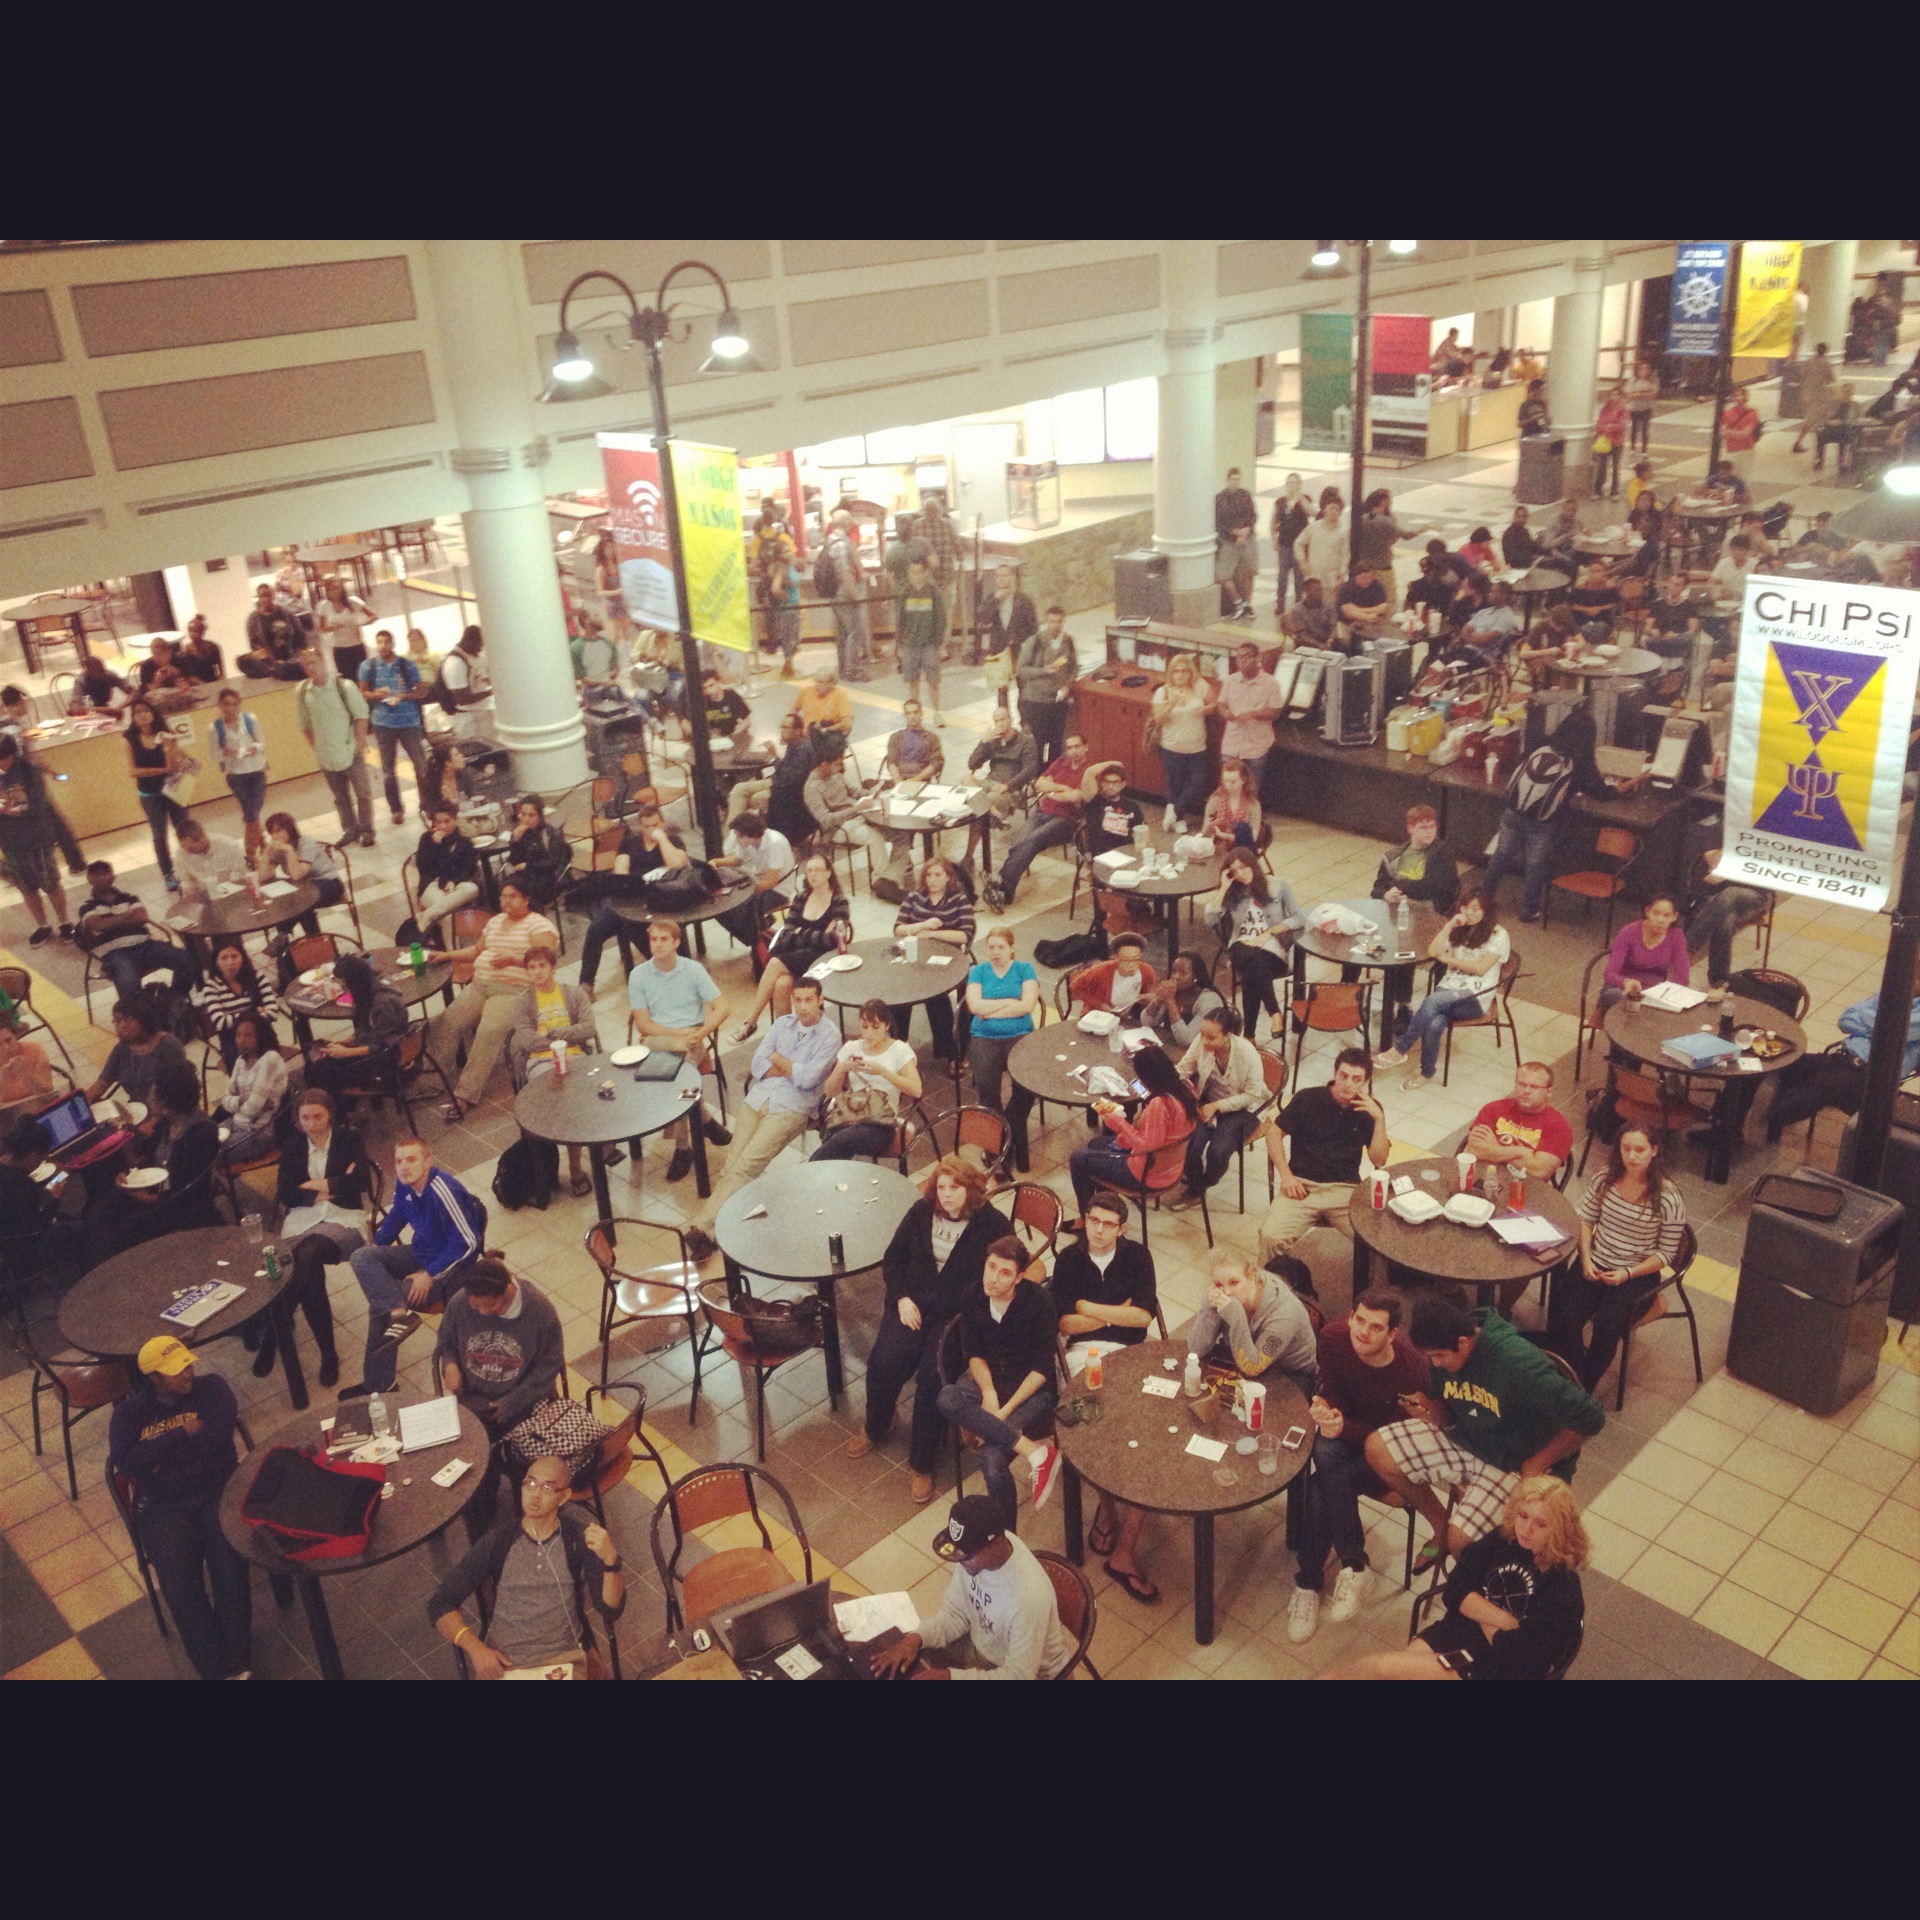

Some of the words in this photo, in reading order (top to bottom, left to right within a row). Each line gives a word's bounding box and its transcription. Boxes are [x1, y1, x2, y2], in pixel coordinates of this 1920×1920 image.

[612, 527, 669, 550] SECURE
[1755, 591, 1827, 627] CHI
[1842, 602, 1912, 638] PSI
[1735, 845, 1882, 885] GENTLEMEN
[1739, 832, 1878, 870] PROMOTING
[1742, 862, 1812, 886] SINCE
[1816, 878, 1867, 898] 1841
[1443, 1380, 1501, 1418] MASON
